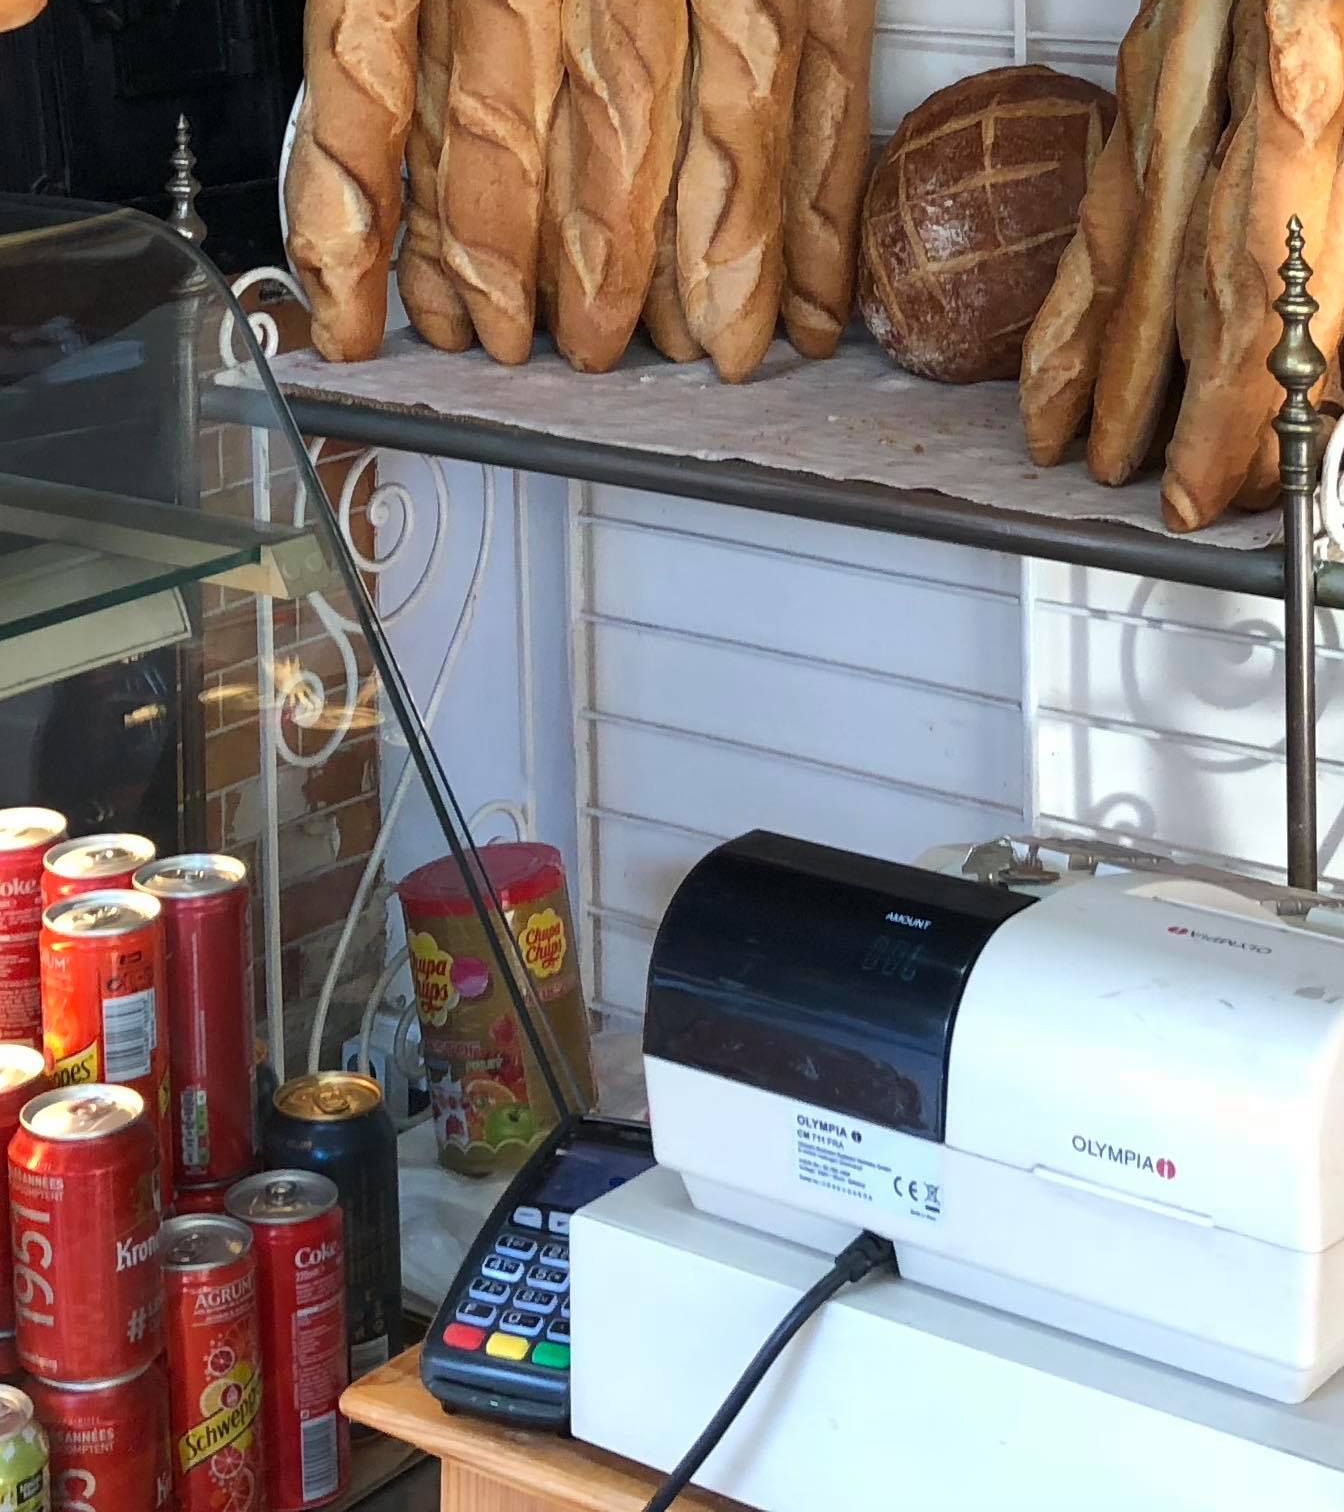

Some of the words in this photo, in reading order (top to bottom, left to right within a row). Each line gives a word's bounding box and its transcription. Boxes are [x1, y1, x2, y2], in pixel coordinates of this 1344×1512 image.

[526, 922, 561, 945] Chupa
[797, 1114, 847, 1139] OLYMPIA
[1072, 1134, 1154, 1173] OLYMPIA
[116, 1233, 160, 1273] Kron
[194, 1276, 253, 1310] AGRUM
